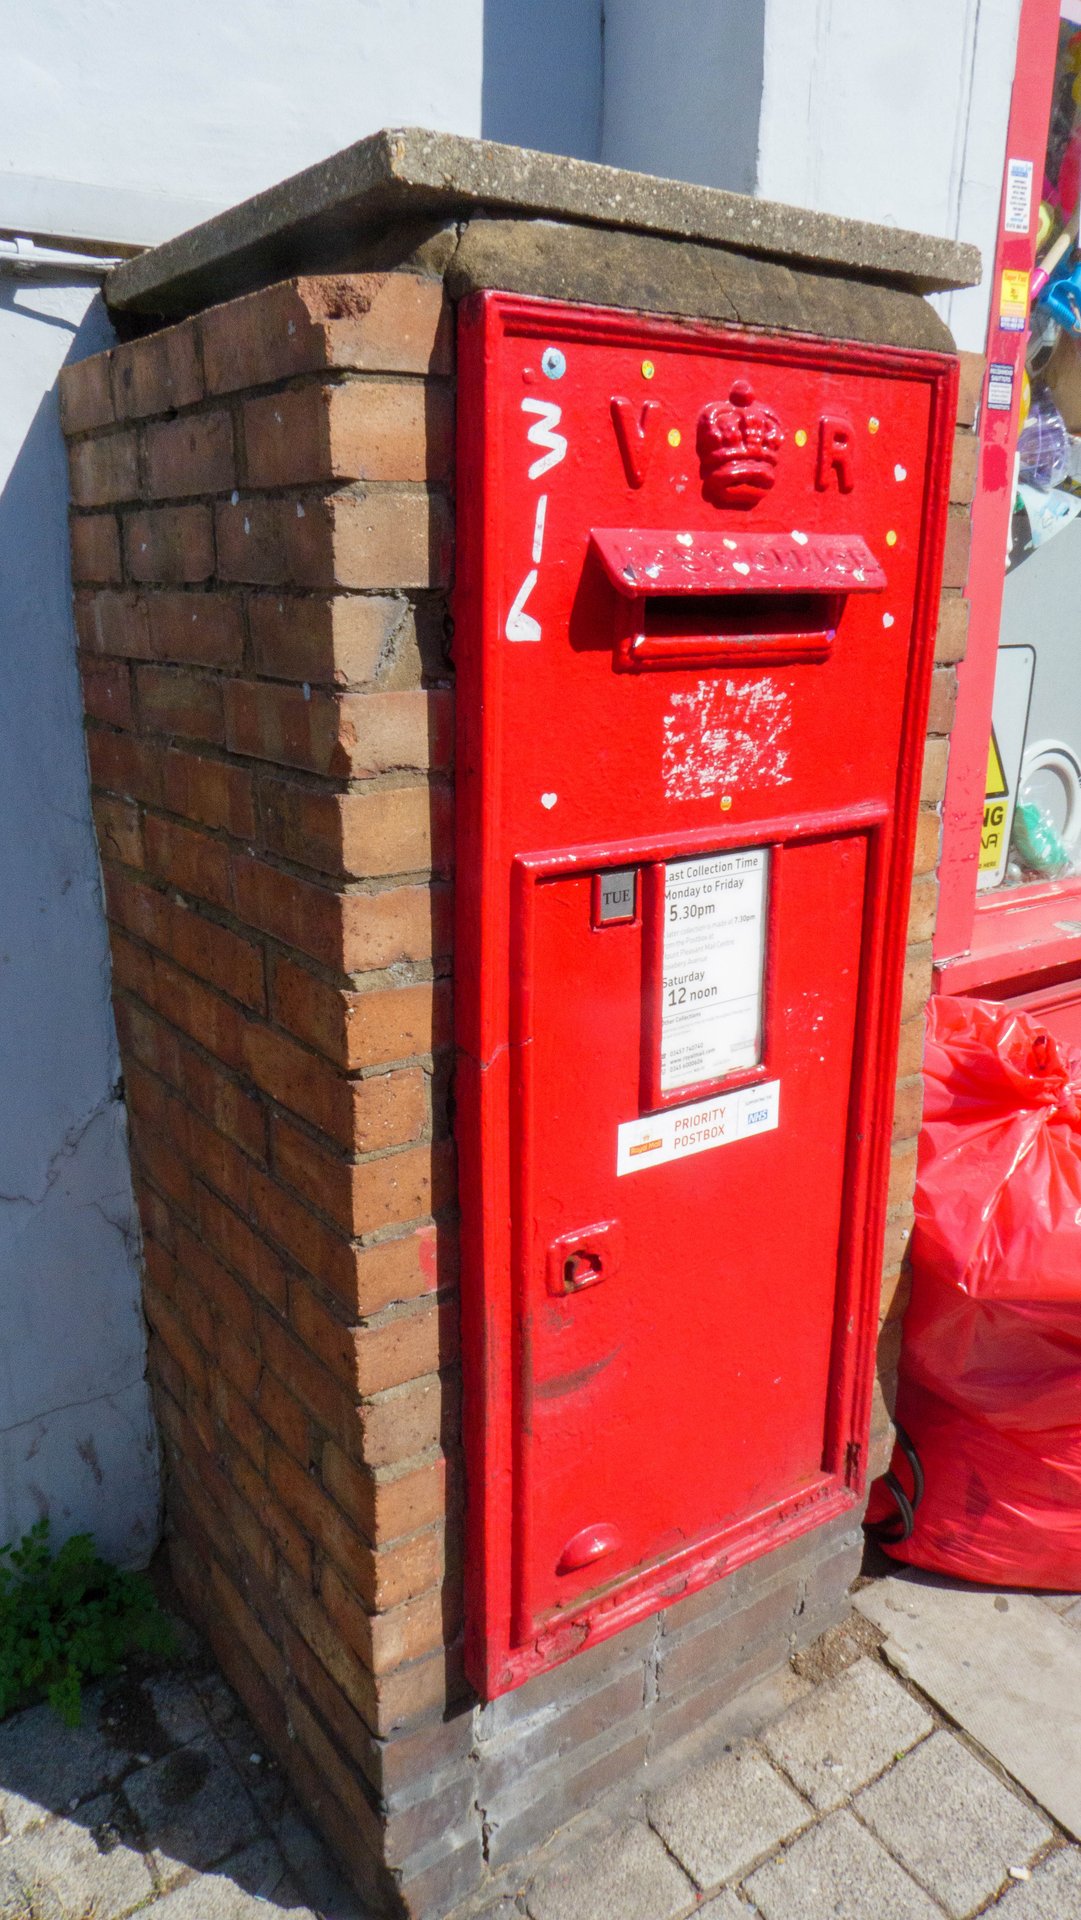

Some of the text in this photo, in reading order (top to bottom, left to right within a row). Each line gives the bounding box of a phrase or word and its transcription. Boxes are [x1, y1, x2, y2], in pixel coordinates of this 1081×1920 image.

[610, 396, 855, 493] V R
[666, 857, 759, 882] ast Collection Time
[703, 884, 713, 894] to
[715, 878, 744, 892] Friday
[602, 889, 632, 905] TUE
[669, 903, 716, 922] 5.30pm
[663, 970, 705, 988] Saturday
[668, 986, 718, 1007] 12 noon
[674, 1107, 726, 1132] PRIORITY
[748, 1110, 767, 1124] NHS
[673, 1124, 725, 1149] POSTBOX
